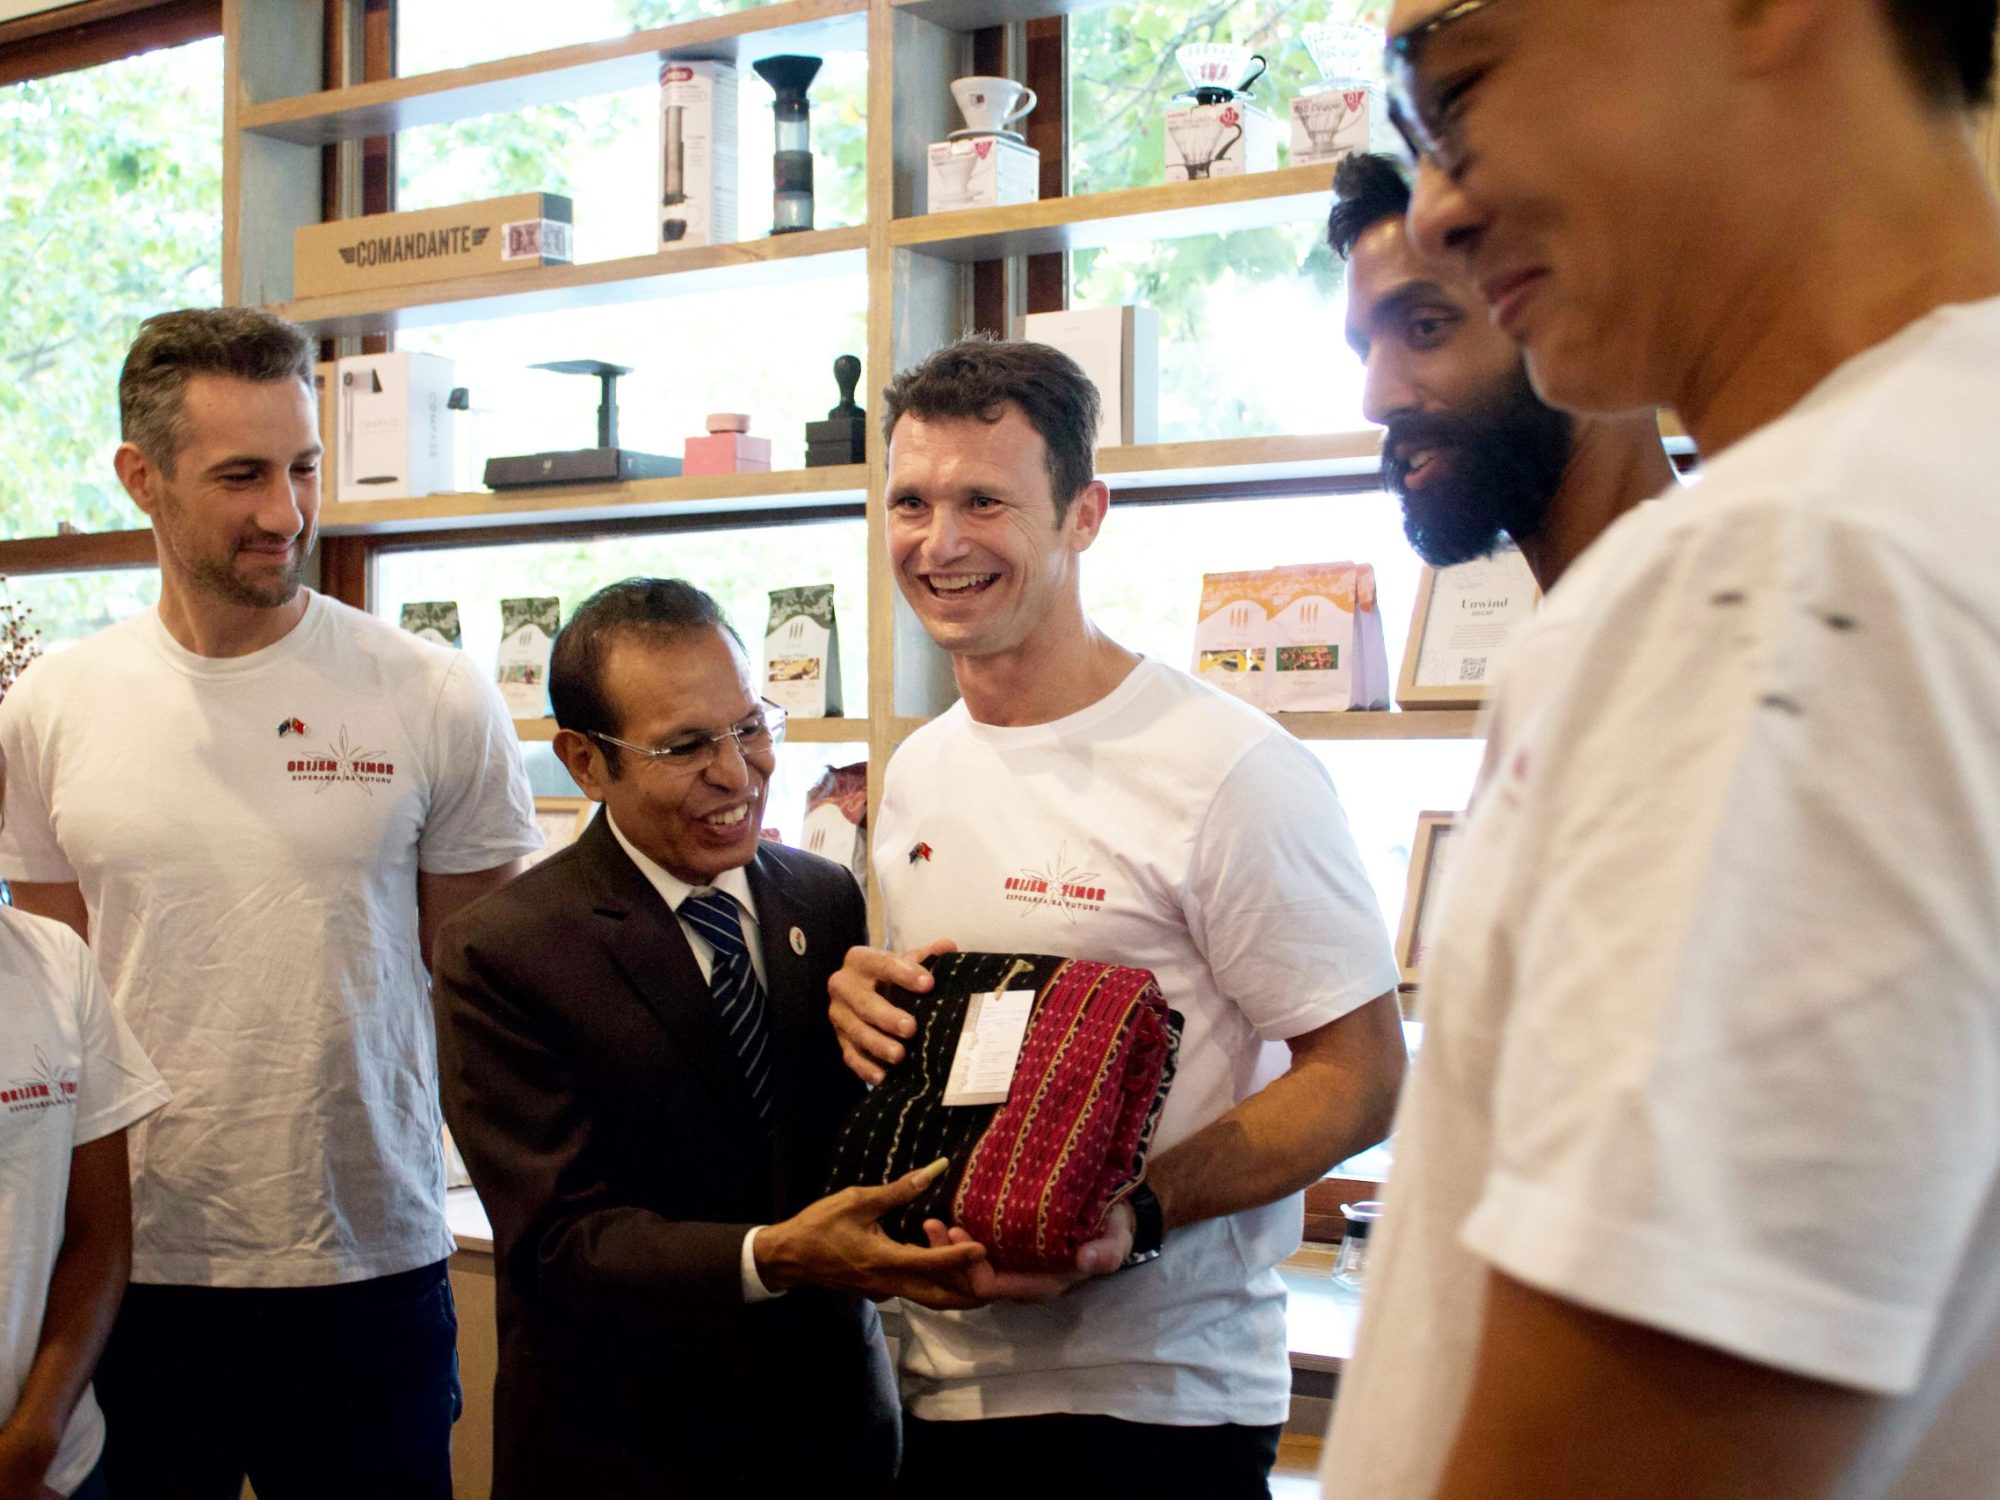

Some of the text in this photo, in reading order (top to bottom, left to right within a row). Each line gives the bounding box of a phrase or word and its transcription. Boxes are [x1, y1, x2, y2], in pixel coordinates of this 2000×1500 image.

[356, 226, 471, 268] COMANDANTE
[1461, 597, 1509, 609] Unwind
[287, 760, 394, 775] ORIJEM TIMOR
[1004, 877, 1106, 901] ORIJEM TIMOR
[0, 1084, 49, 1103] ORIJEM
